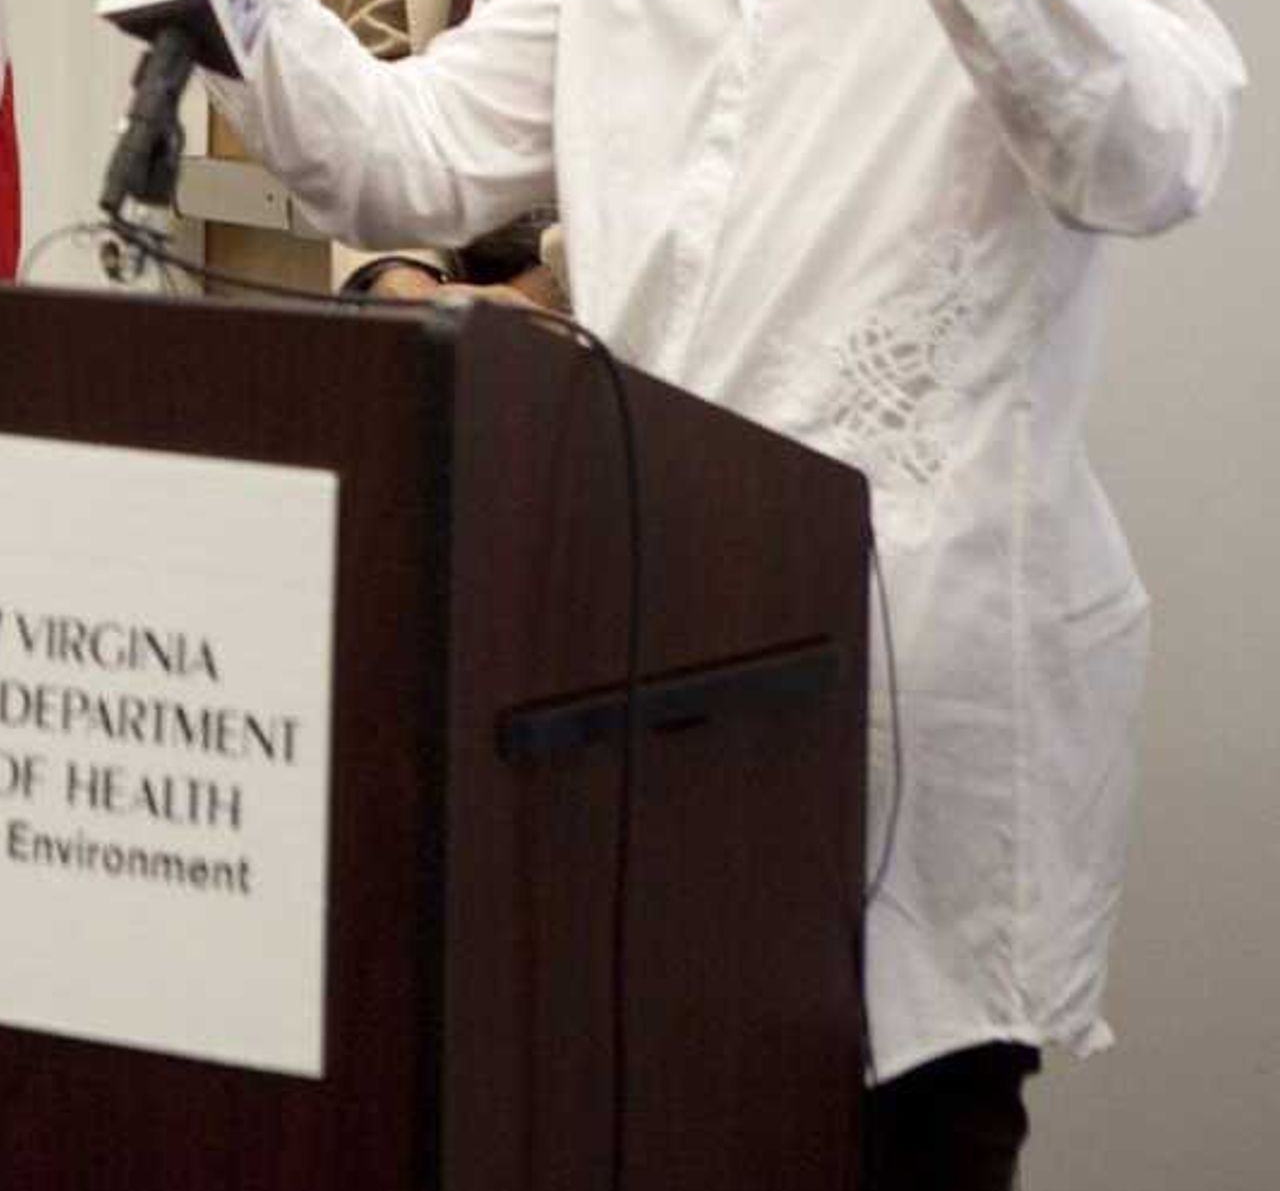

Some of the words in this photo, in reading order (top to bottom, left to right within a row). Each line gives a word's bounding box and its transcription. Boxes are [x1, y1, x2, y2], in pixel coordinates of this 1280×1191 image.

[14, 612, 219, 681] VIRGINIA
[66, 761, 242, 831] HEALTH
[7, 820, 251, 895] Environment
